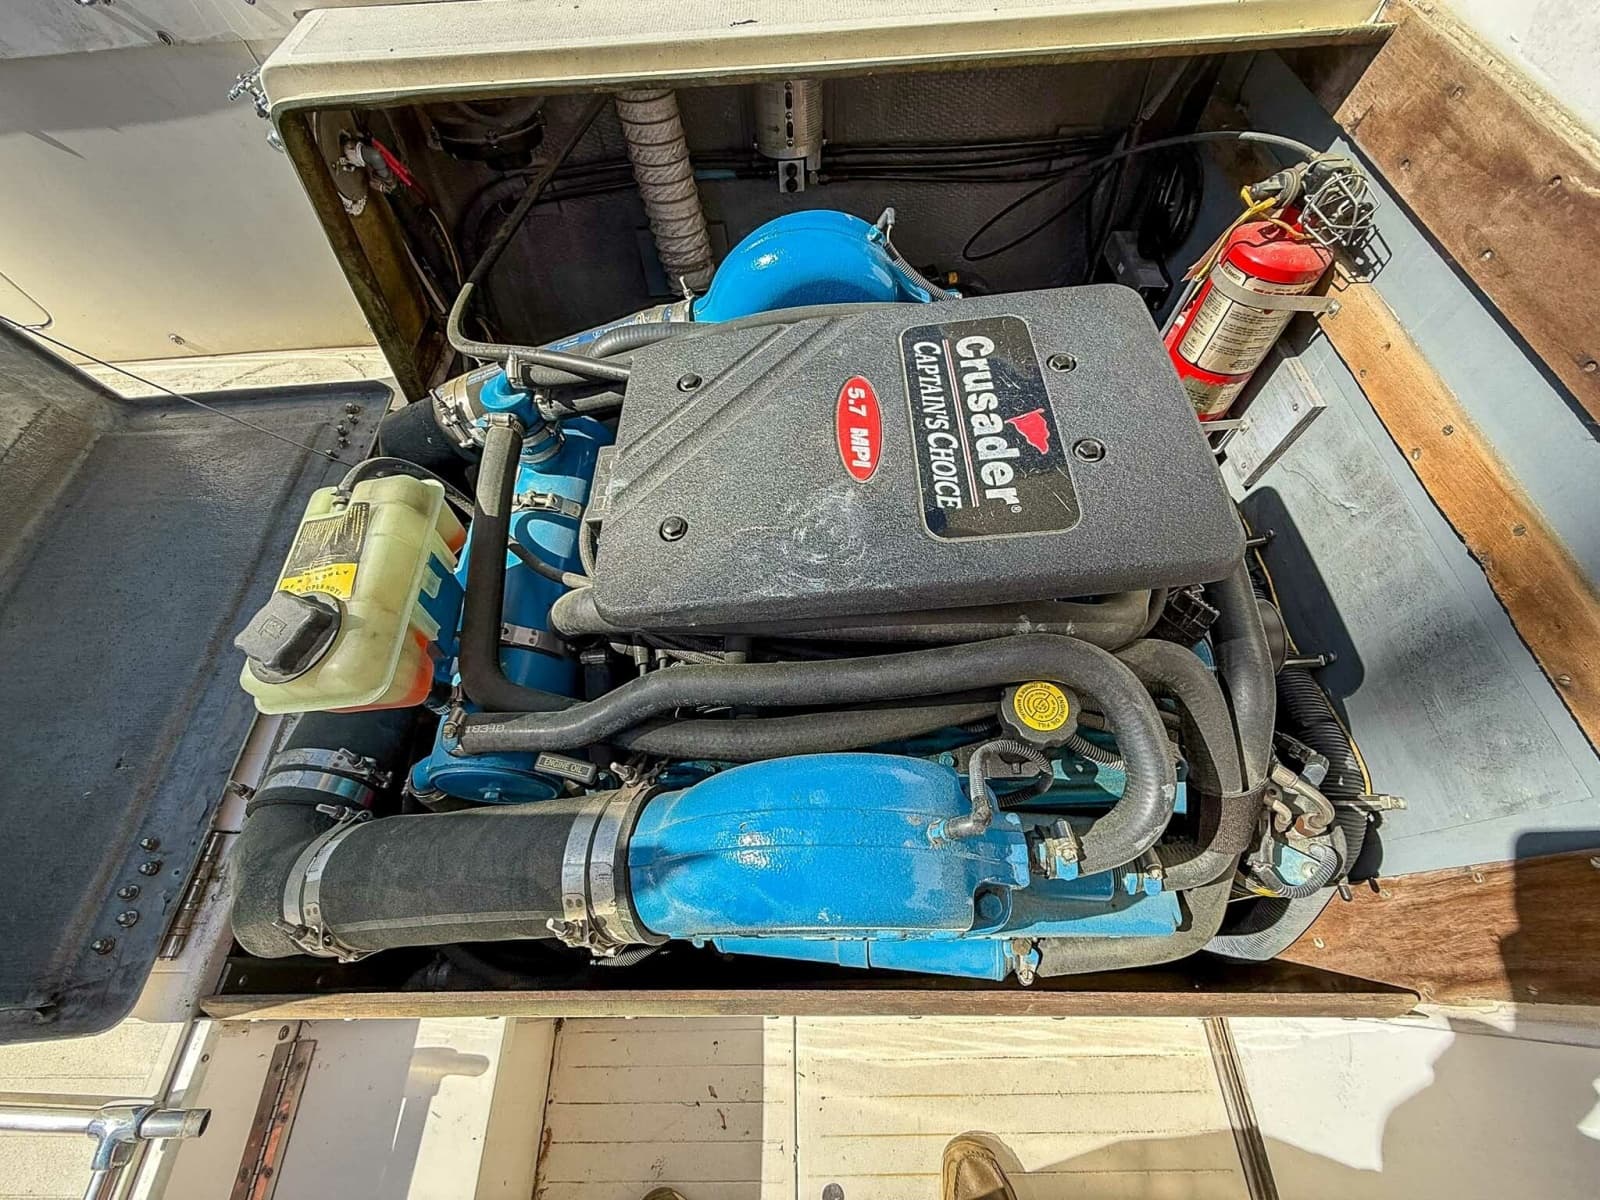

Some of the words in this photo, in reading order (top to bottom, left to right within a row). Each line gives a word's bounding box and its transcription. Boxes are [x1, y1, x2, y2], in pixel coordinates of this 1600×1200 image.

[847, 387, 867, 417] 5.7
[912, 341, 950, 430] CAPTAIN'S
[850, 427, 872, 469] MPI
[927, 431, 963, 510] CHOICE
[543, 758, 569, 770] ENGINE
[570, 763, 583, 774] OIL
